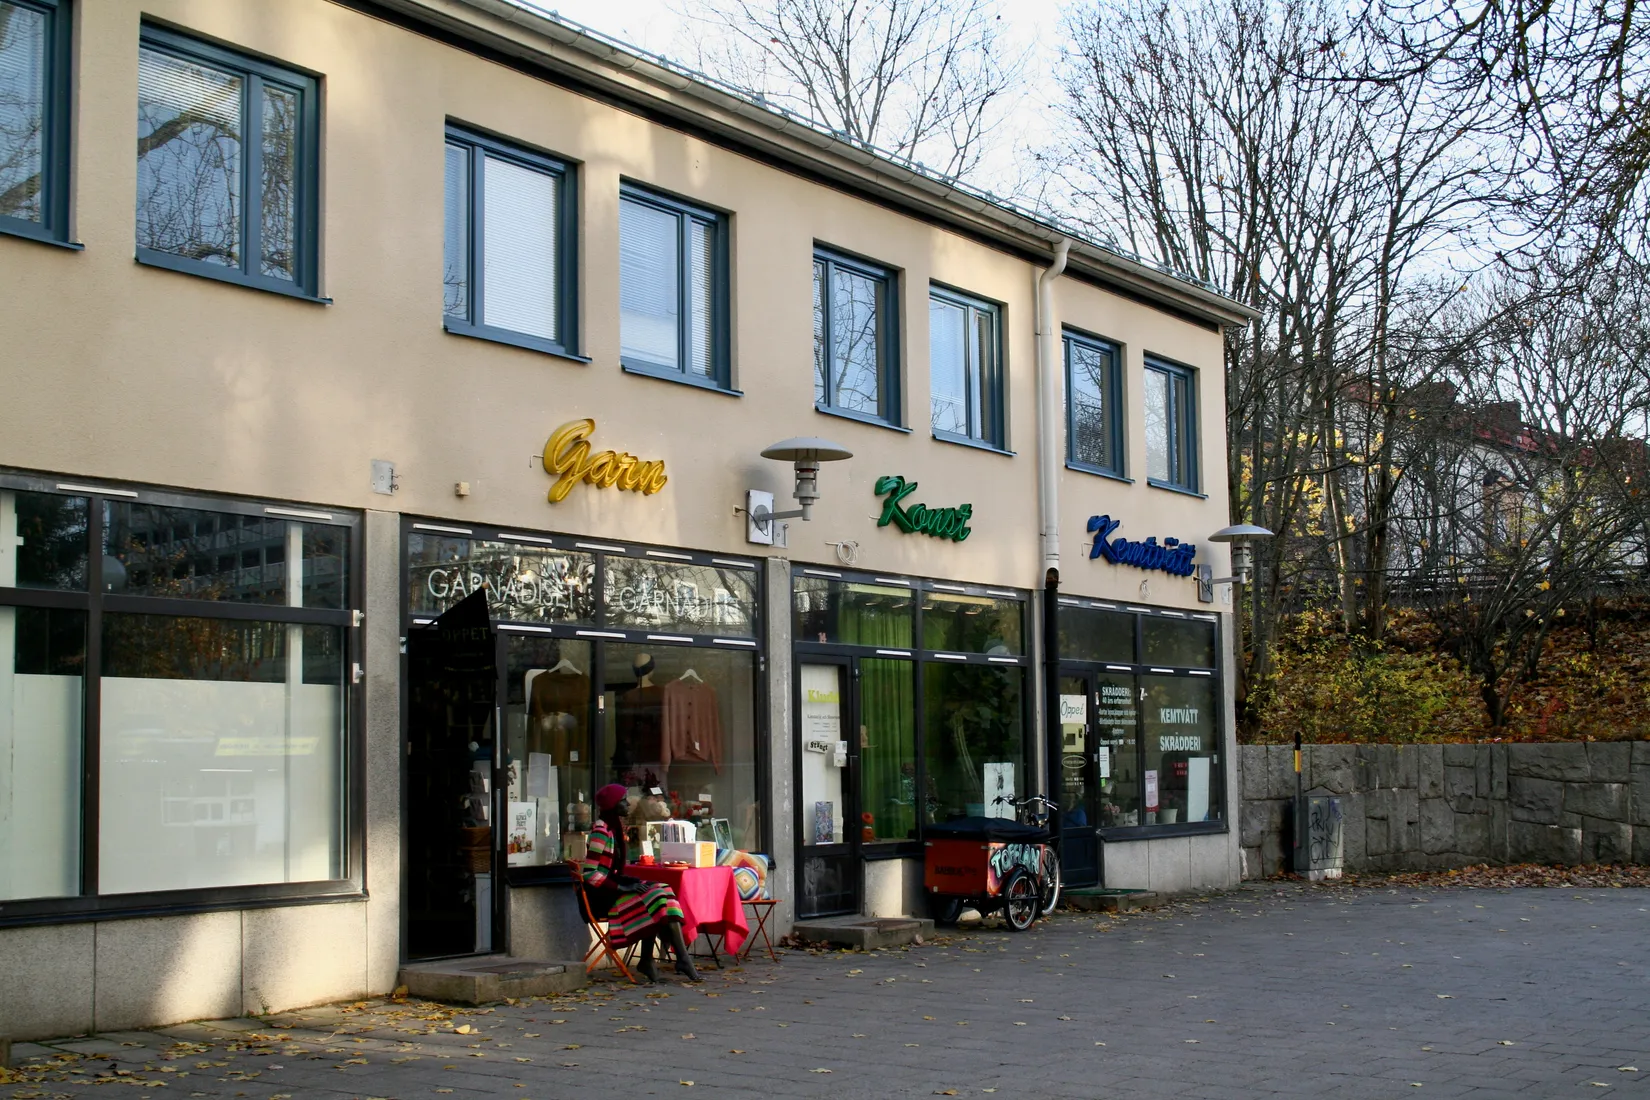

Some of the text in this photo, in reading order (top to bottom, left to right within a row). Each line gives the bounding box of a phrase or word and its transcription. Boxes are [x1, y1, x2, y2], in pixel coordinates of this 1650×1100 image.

[543, 418, 668, 504] Garn
[874, 475, 973, 542] Konst
[1086, 514, 1196, 577] Kemtvätt
[1060, 698, 1085, 718] Öppet
[1160, 704, 1199, 724] KEMTVÄTT
[1159, 731, 1201, 751] SKRÄDDERI
